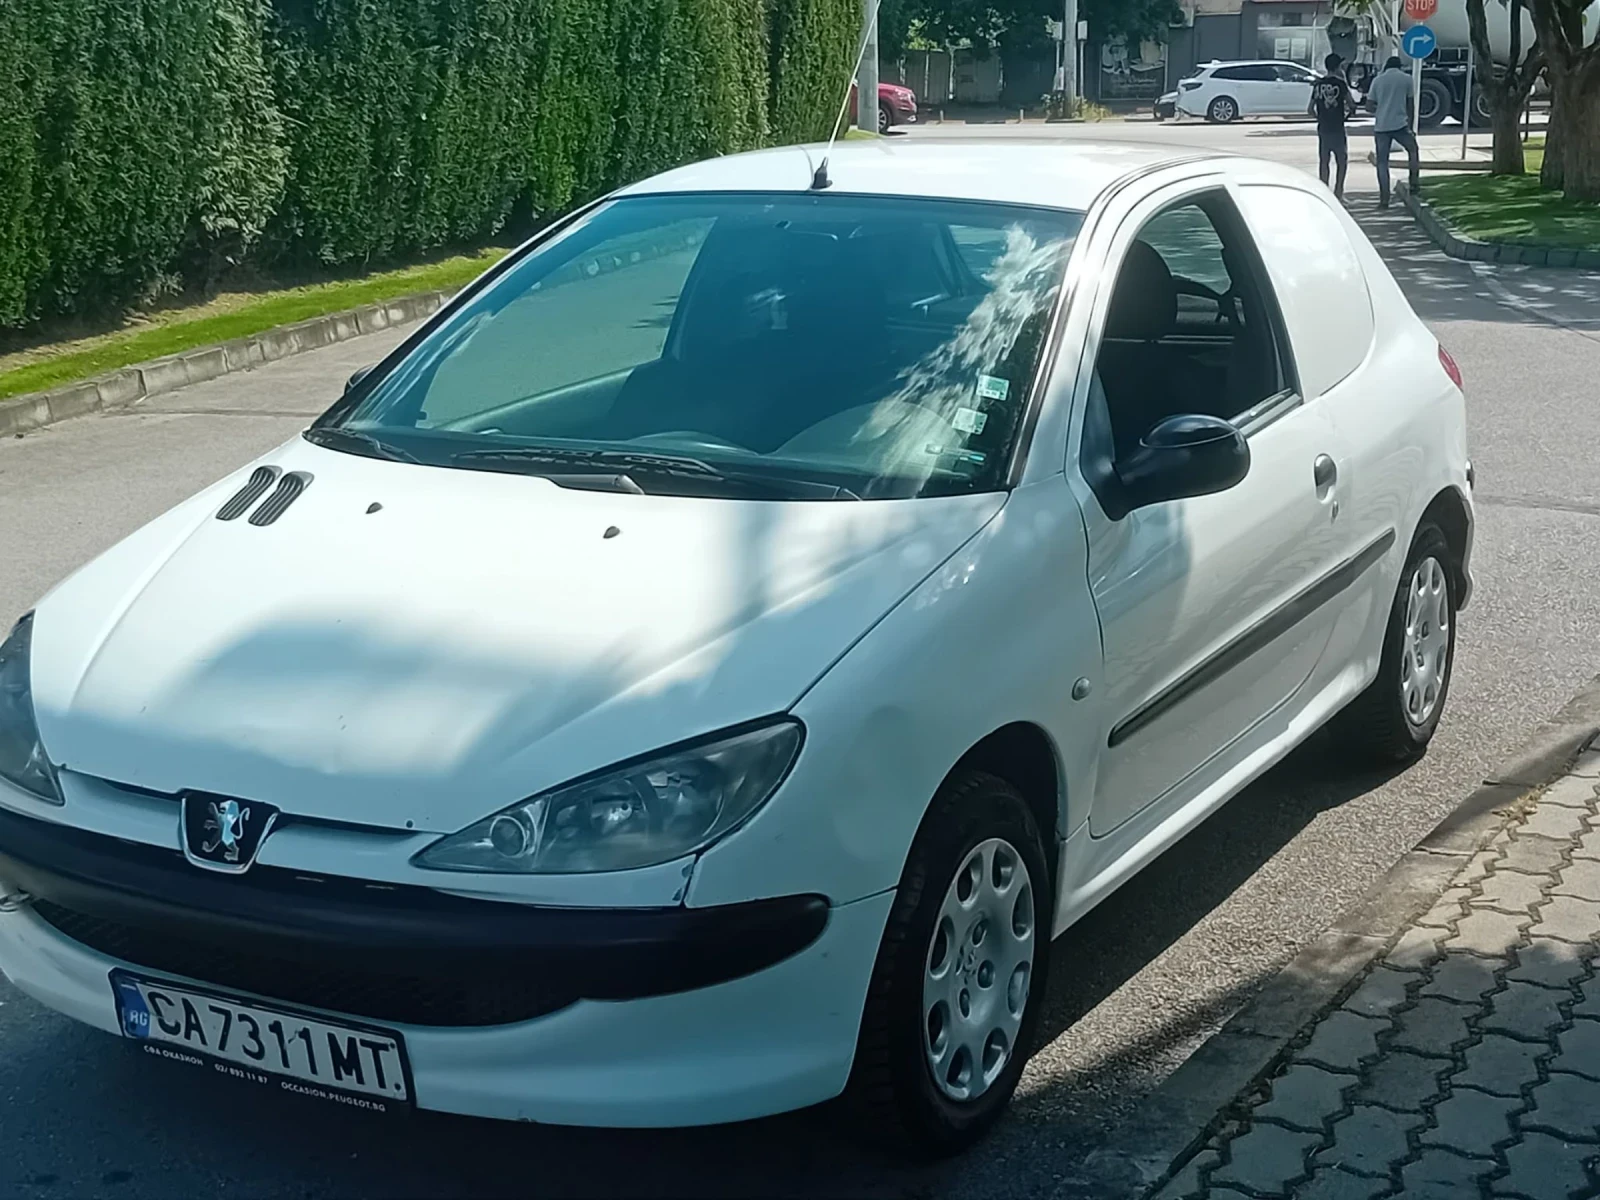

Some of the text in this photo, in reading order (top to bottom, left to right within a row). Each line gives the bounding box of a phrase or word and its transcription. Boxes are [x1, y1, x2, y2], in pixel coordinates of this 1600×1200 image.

[1407, 0, 1435, 10] STOP
[129, 1010, 149, 1026] BG
[281, 1081, 386, 1112] OCCASION.PEUGEOT.BG
